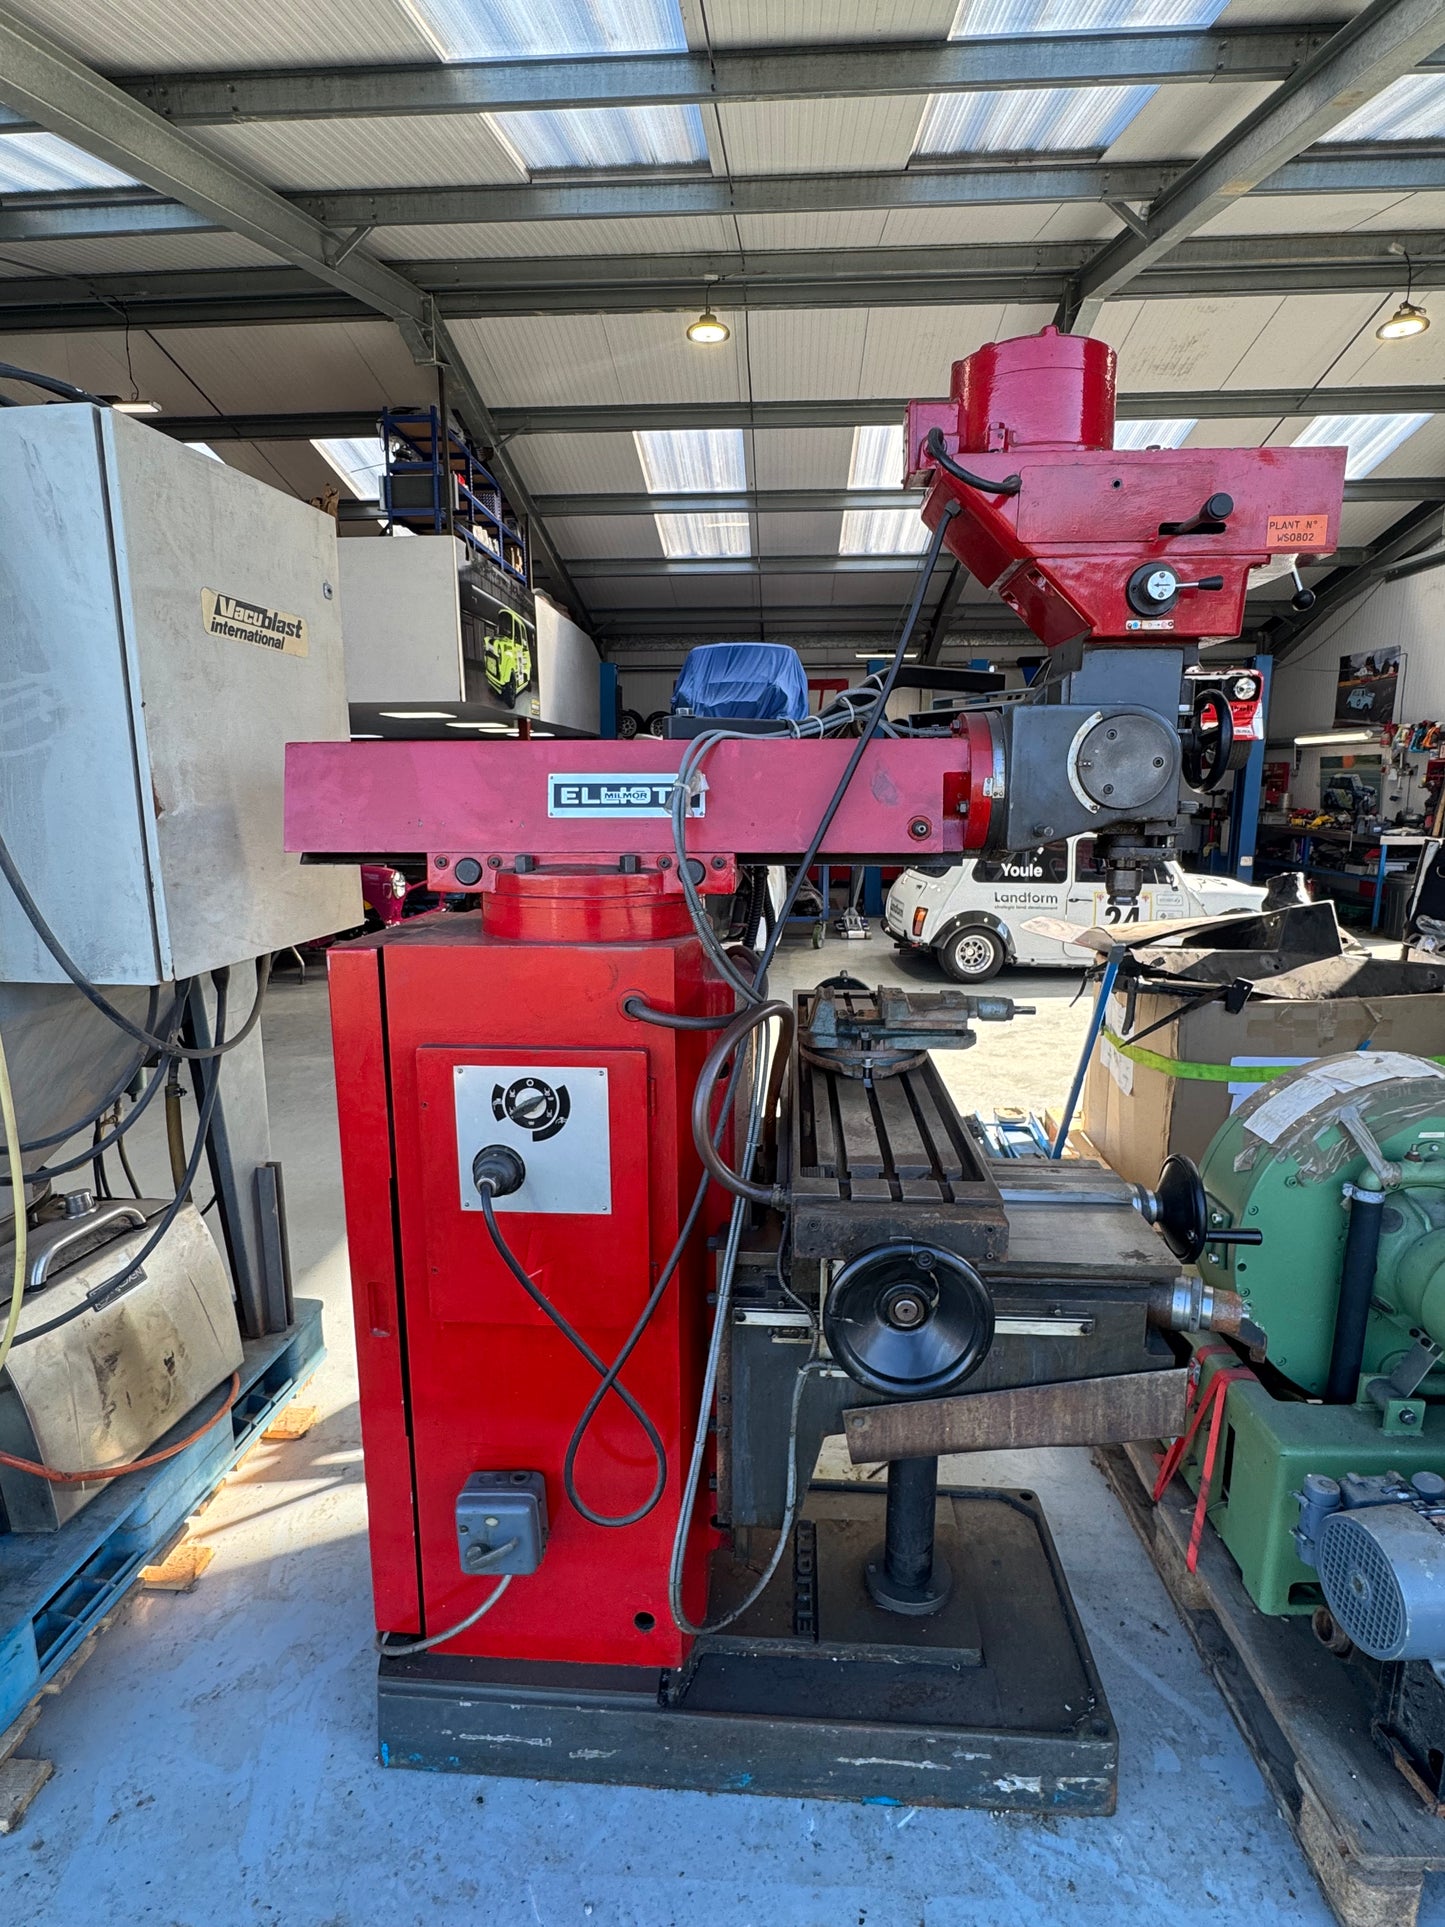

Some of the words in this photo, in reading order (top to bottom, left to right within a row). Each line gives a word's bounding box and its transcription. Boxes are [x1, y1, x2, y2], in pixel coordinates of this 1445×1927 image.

[1269, 520, 1300, 531] PLANT
[217, 594, 303, 639] Vacublast
[210, 616, 285, 650] international
[561, 787, 676, 804] ELLIOT
[605, 792, 648, 800] MILMOR
[1001, 863, 1043, 877] Youle
[994, 891, 1058, 904] Landform
